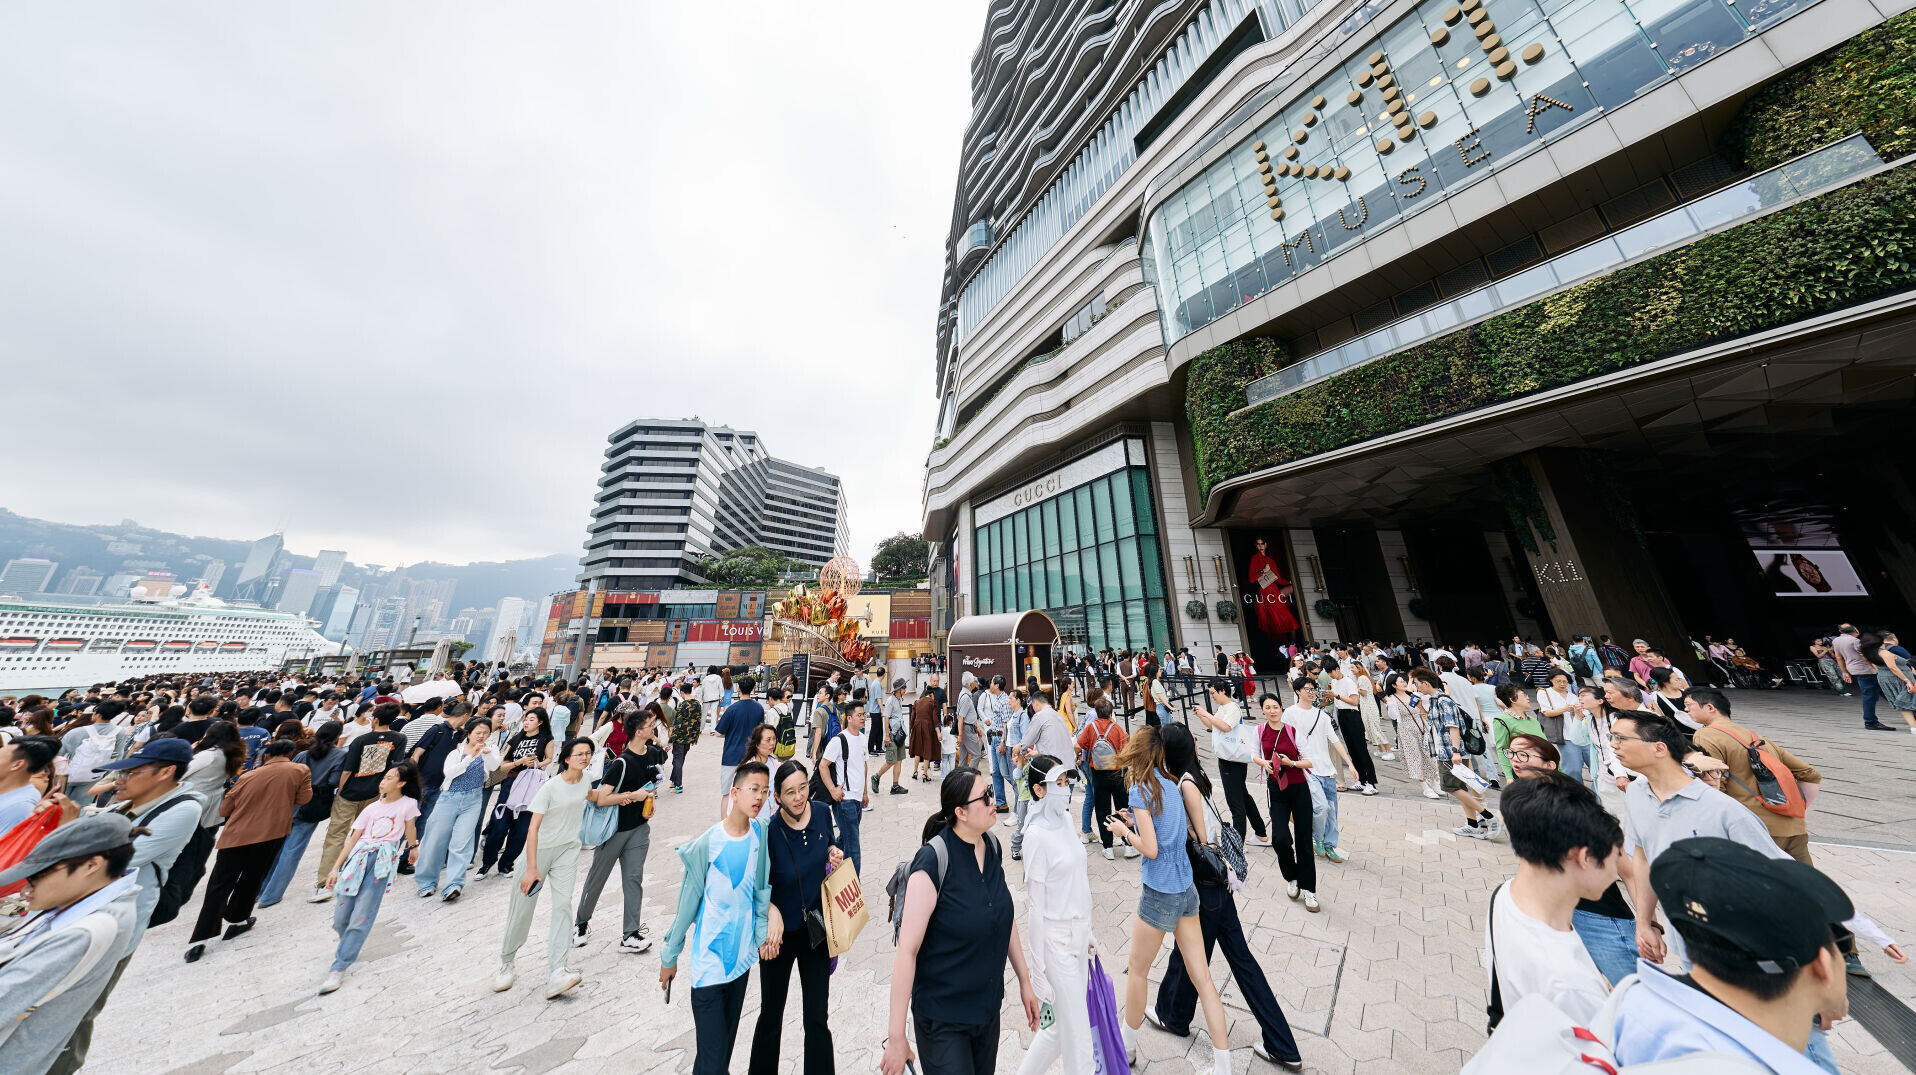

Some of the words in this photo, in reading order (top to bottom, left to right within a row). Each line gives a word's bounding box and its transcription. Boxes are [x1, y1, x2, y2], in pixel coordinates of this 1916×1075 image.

[1252, 0, 1546, 222] K11
[1280, 92, 1574, 267] MUSEA
[1014, 474, 1062, 507] GUCCI
[1534, 559, 1583, 585] K11
[1243, 593, 1293, 604] GUCCI
[723, 626, 754, 636] LOUIS
[835, 878, 862, 913] MUJI
